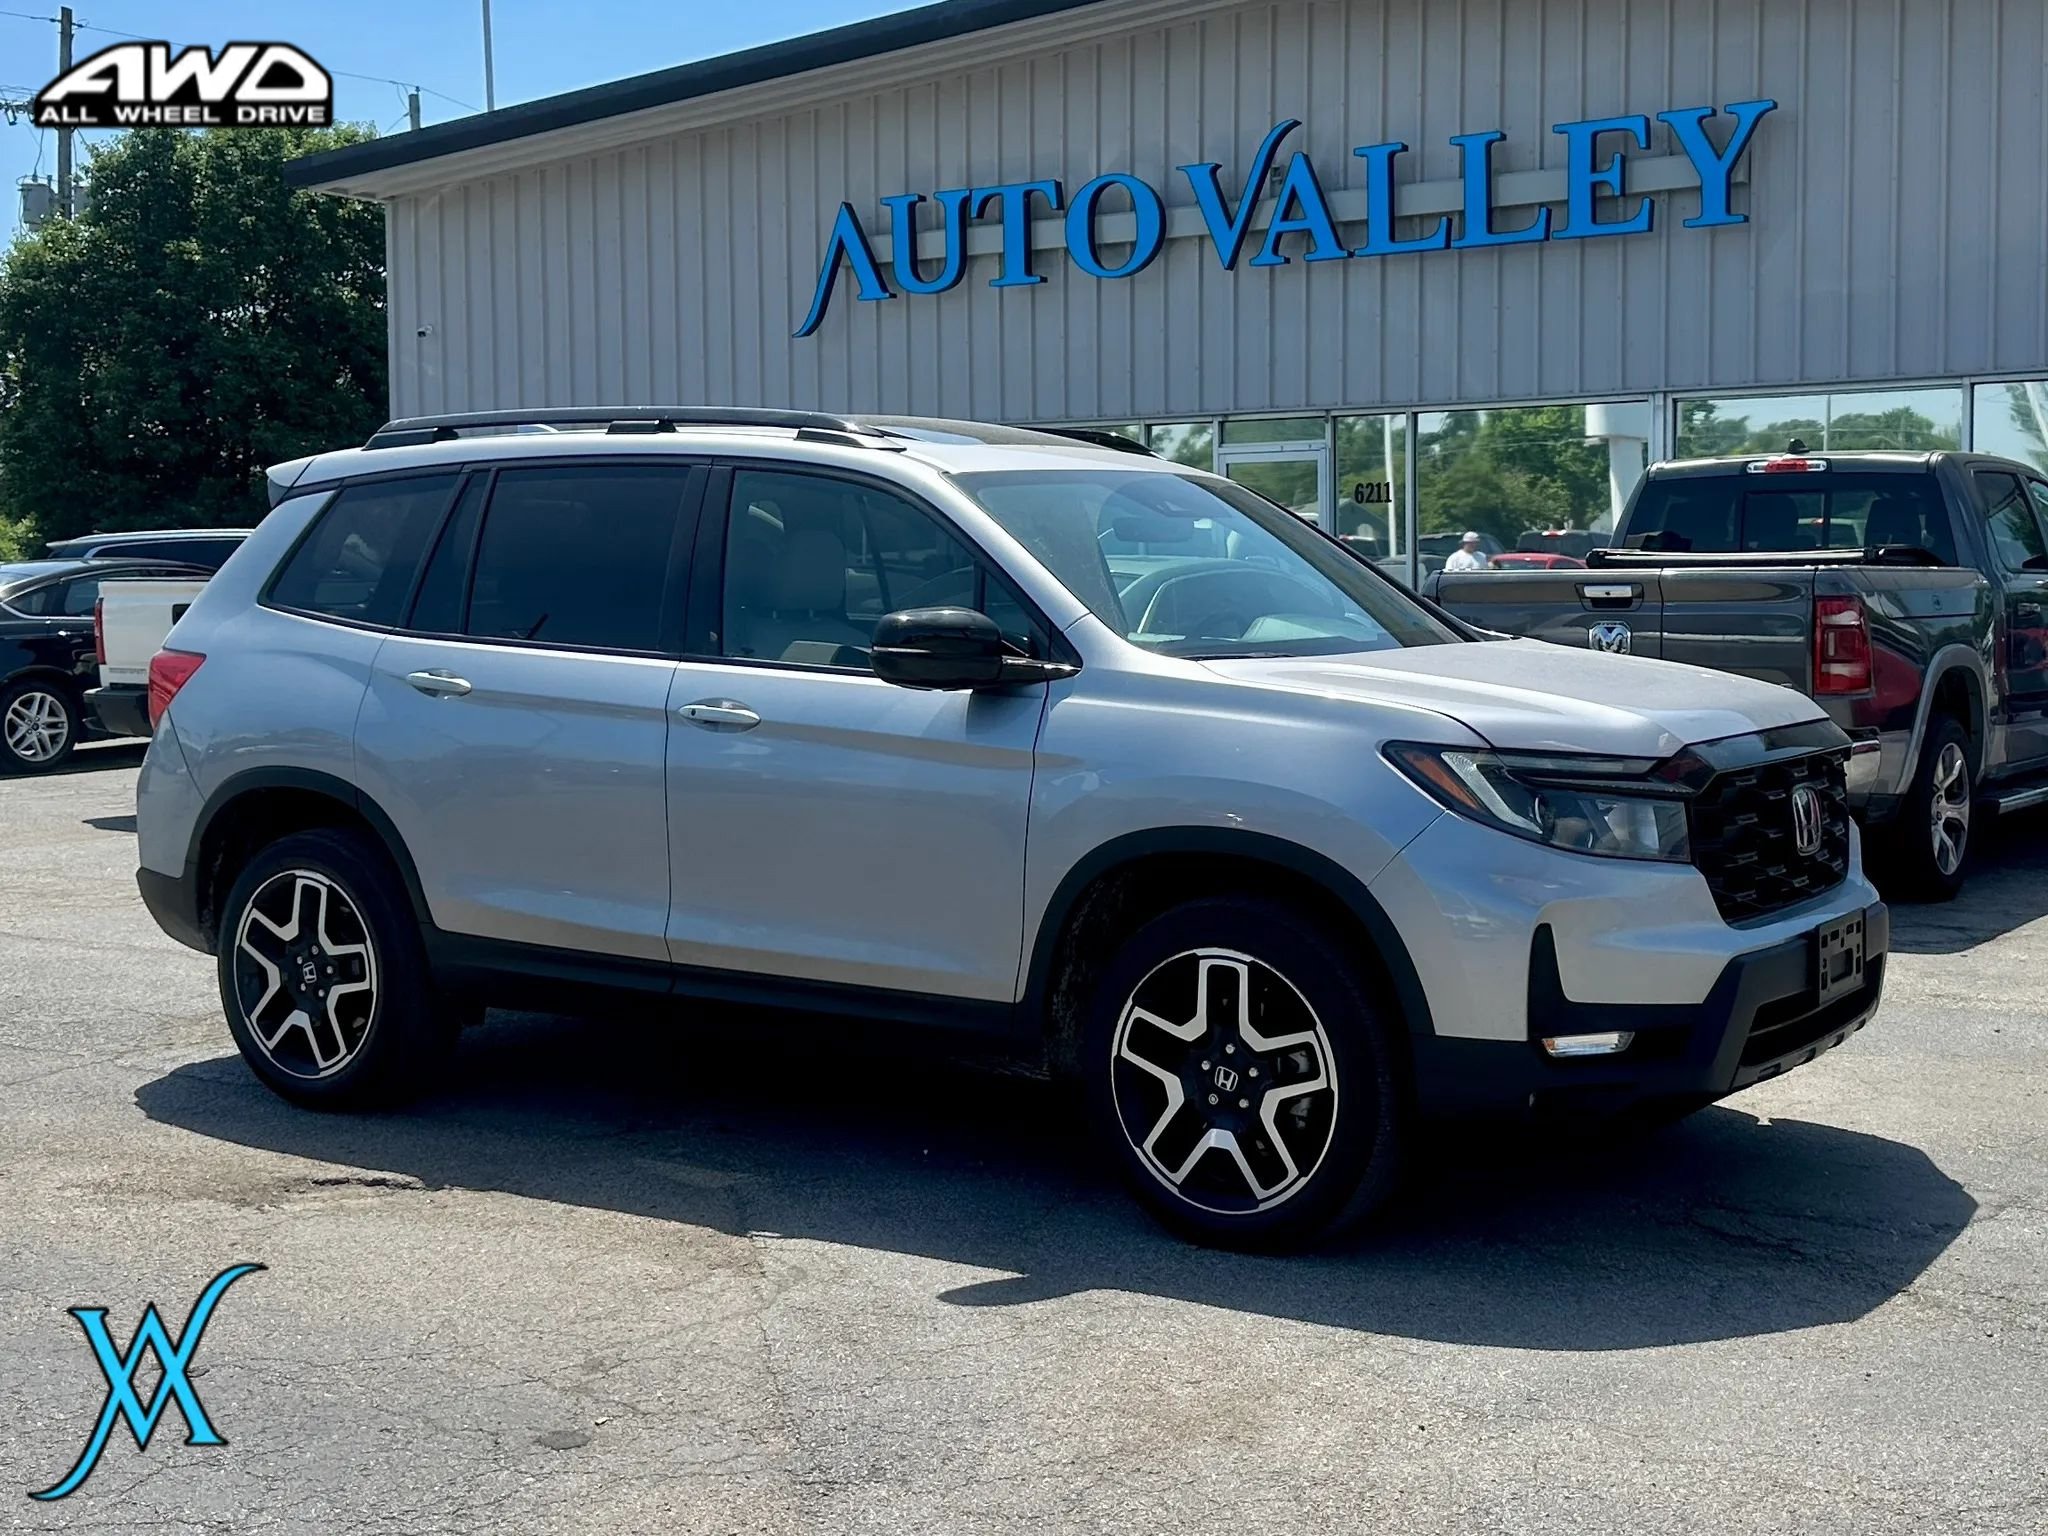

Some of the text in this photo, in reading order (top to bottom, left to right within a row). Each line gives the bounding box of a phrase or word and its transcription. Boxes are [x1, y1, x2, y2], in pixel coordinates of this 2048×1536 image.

[792, 99, 1777, 338] AUTO VALLEY
[1354, 481, 1393, 504] 6211
